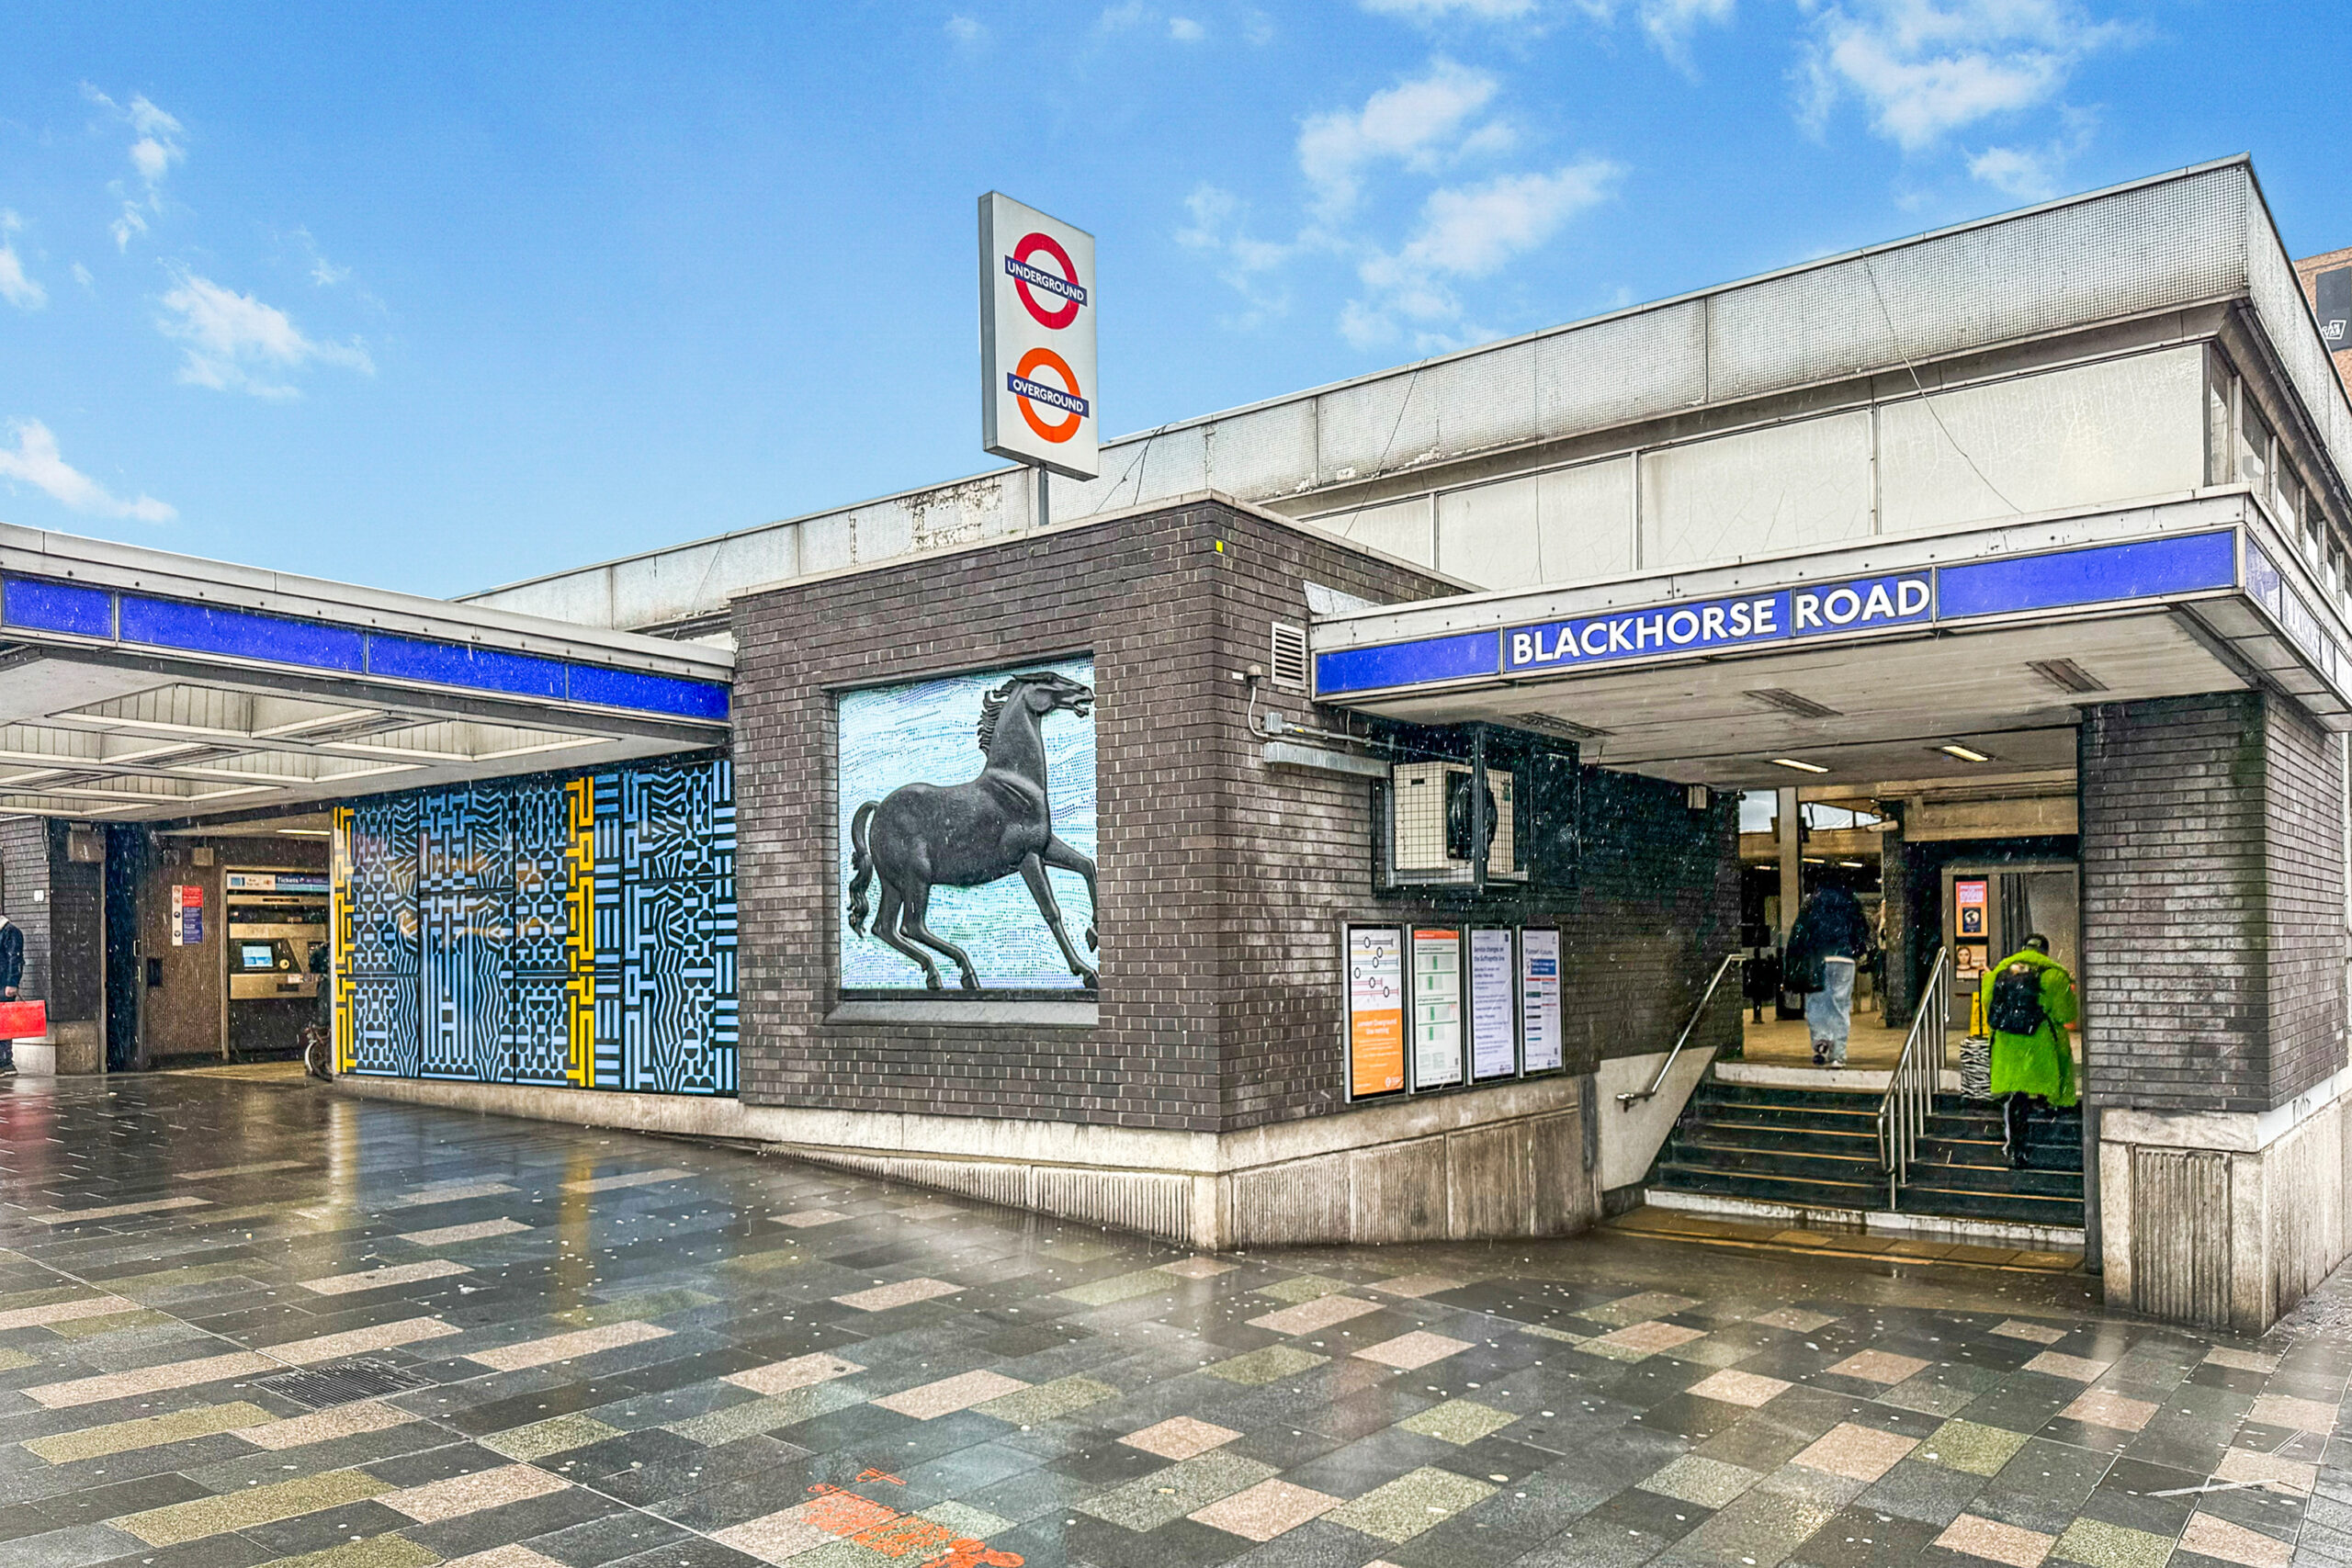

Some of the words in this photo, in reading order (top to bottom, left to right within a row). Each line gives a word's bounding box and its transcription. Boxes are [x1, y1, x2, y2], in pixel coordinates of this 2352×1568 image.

[1007, 260, 1085, 302] UNDERGROUND
[1012, 378, 1084, 413] OVERGROUND
[1512, 599, 1777, 665] BLACKHORSE
[1795, 580, 1930, 629] ROAD
